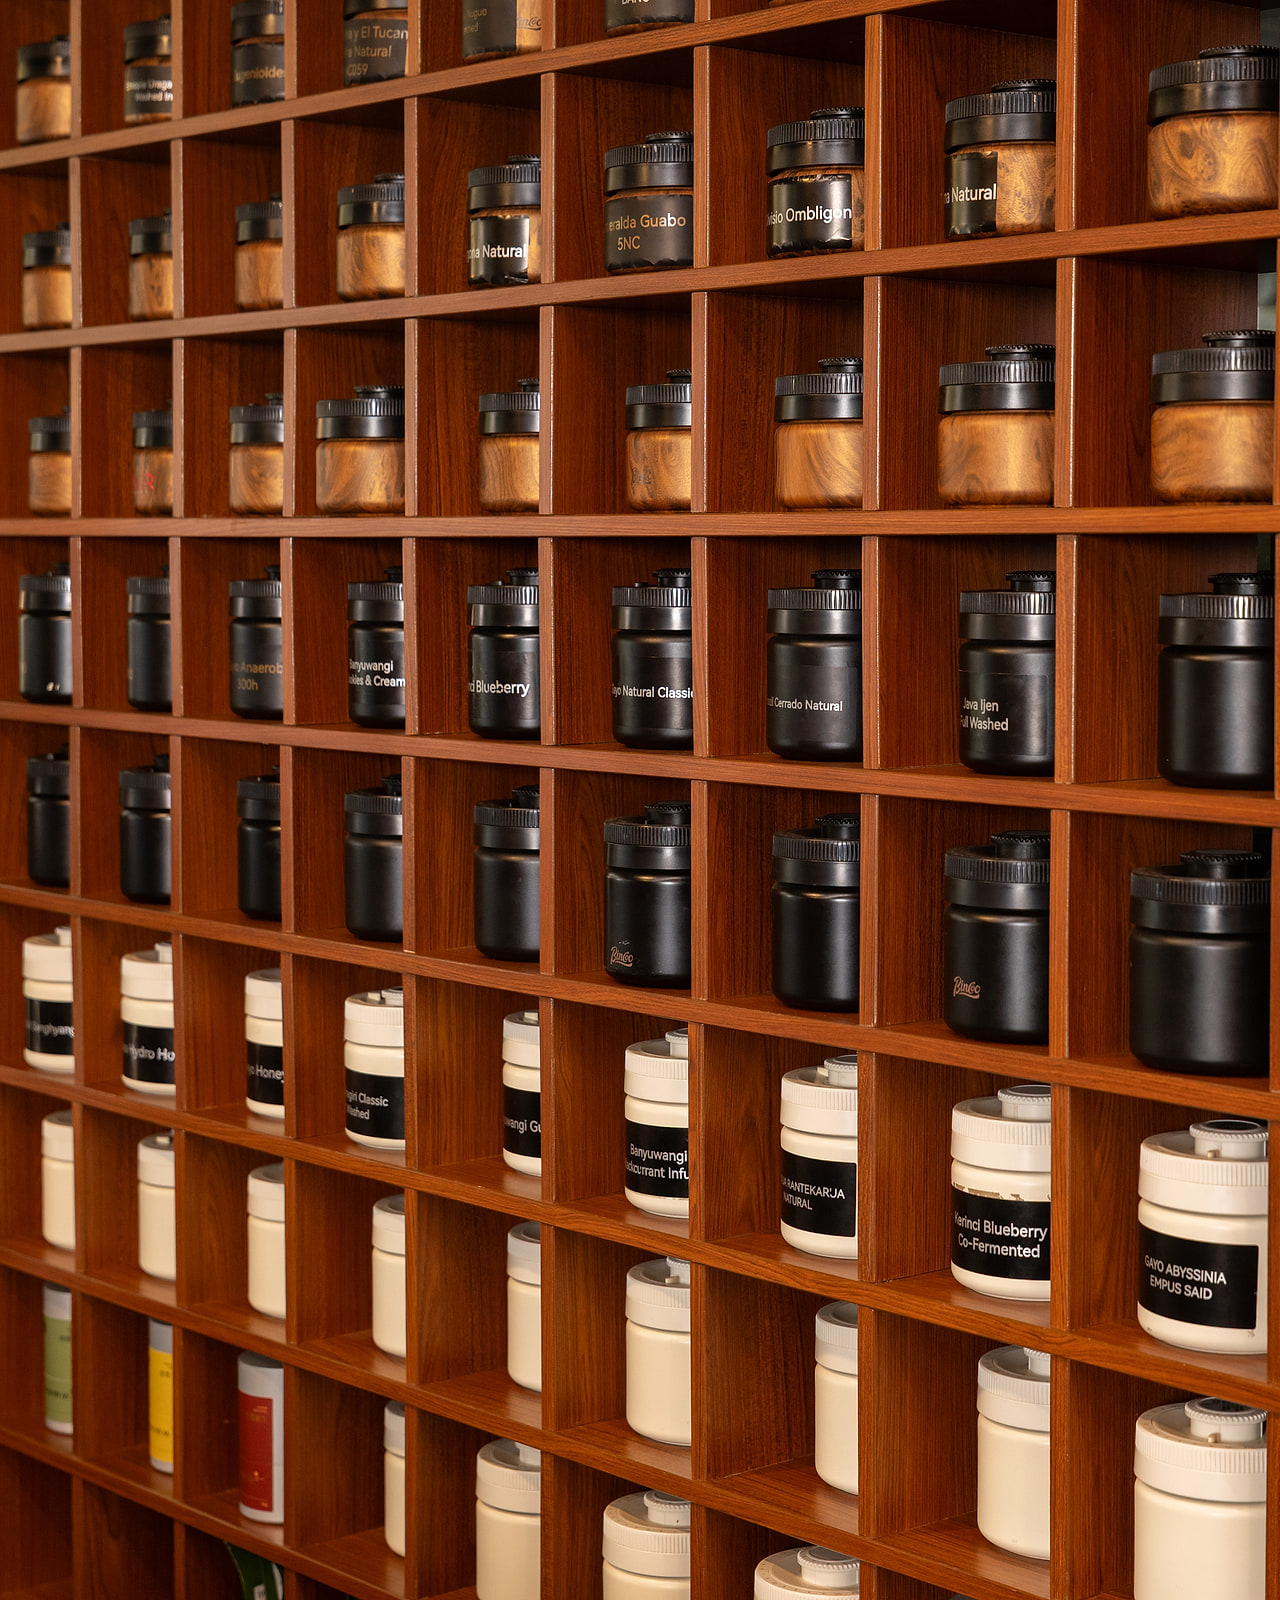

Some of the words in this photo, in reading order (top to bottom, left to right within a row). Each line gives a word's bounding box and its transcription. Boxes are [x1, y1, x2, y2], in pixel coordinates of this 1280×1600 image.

[361, 25, 370, 38] El
[373, 25, 409, 39] Tucan
[354, 44, 392, 57] Natural
[951, 183, 997, 203] Natural
[606, 215, 637, 232] eralda
[640, 212, 687, 228] Guabo
[785, 205, 852, 224] Ombligon
[482, 243, 527, 258] Natural
[617, 235, 641, 251] 5NC
[240, 661, 283, 674] Anaerob
[365, 674, 372, 687] &
[476, 680, 531, 698] Blueberry
[622, 684, 655, 698] Natural
[774, 697, 803, 710] Cerrado
[805, 699, 844, 712] Natural
[963, 696, 979, 710] Java
[980, 698, 999, 715] Ijen
[969, 716, 1009, 731] Washed
[358, 1092, 389, 1107] Classic
[630, 1143, 688, 1165] Banyuwangi
[783, 1190, 813, 1211] NATURAL
[954, 1210, 981, 1232] Kerinci
[983, 1219, 1048, 1242] Blueberry
[958, 1232, 1041, 1258] Co-Fermented
[1144, 1254, 1165, 1273] GAYO
[1165, 1263, 1228, 1286] ABYSSINIA
[1150, 1274, 1182, 1295] EMPUS
[1183, 1284, 1213, 1301] SAID
